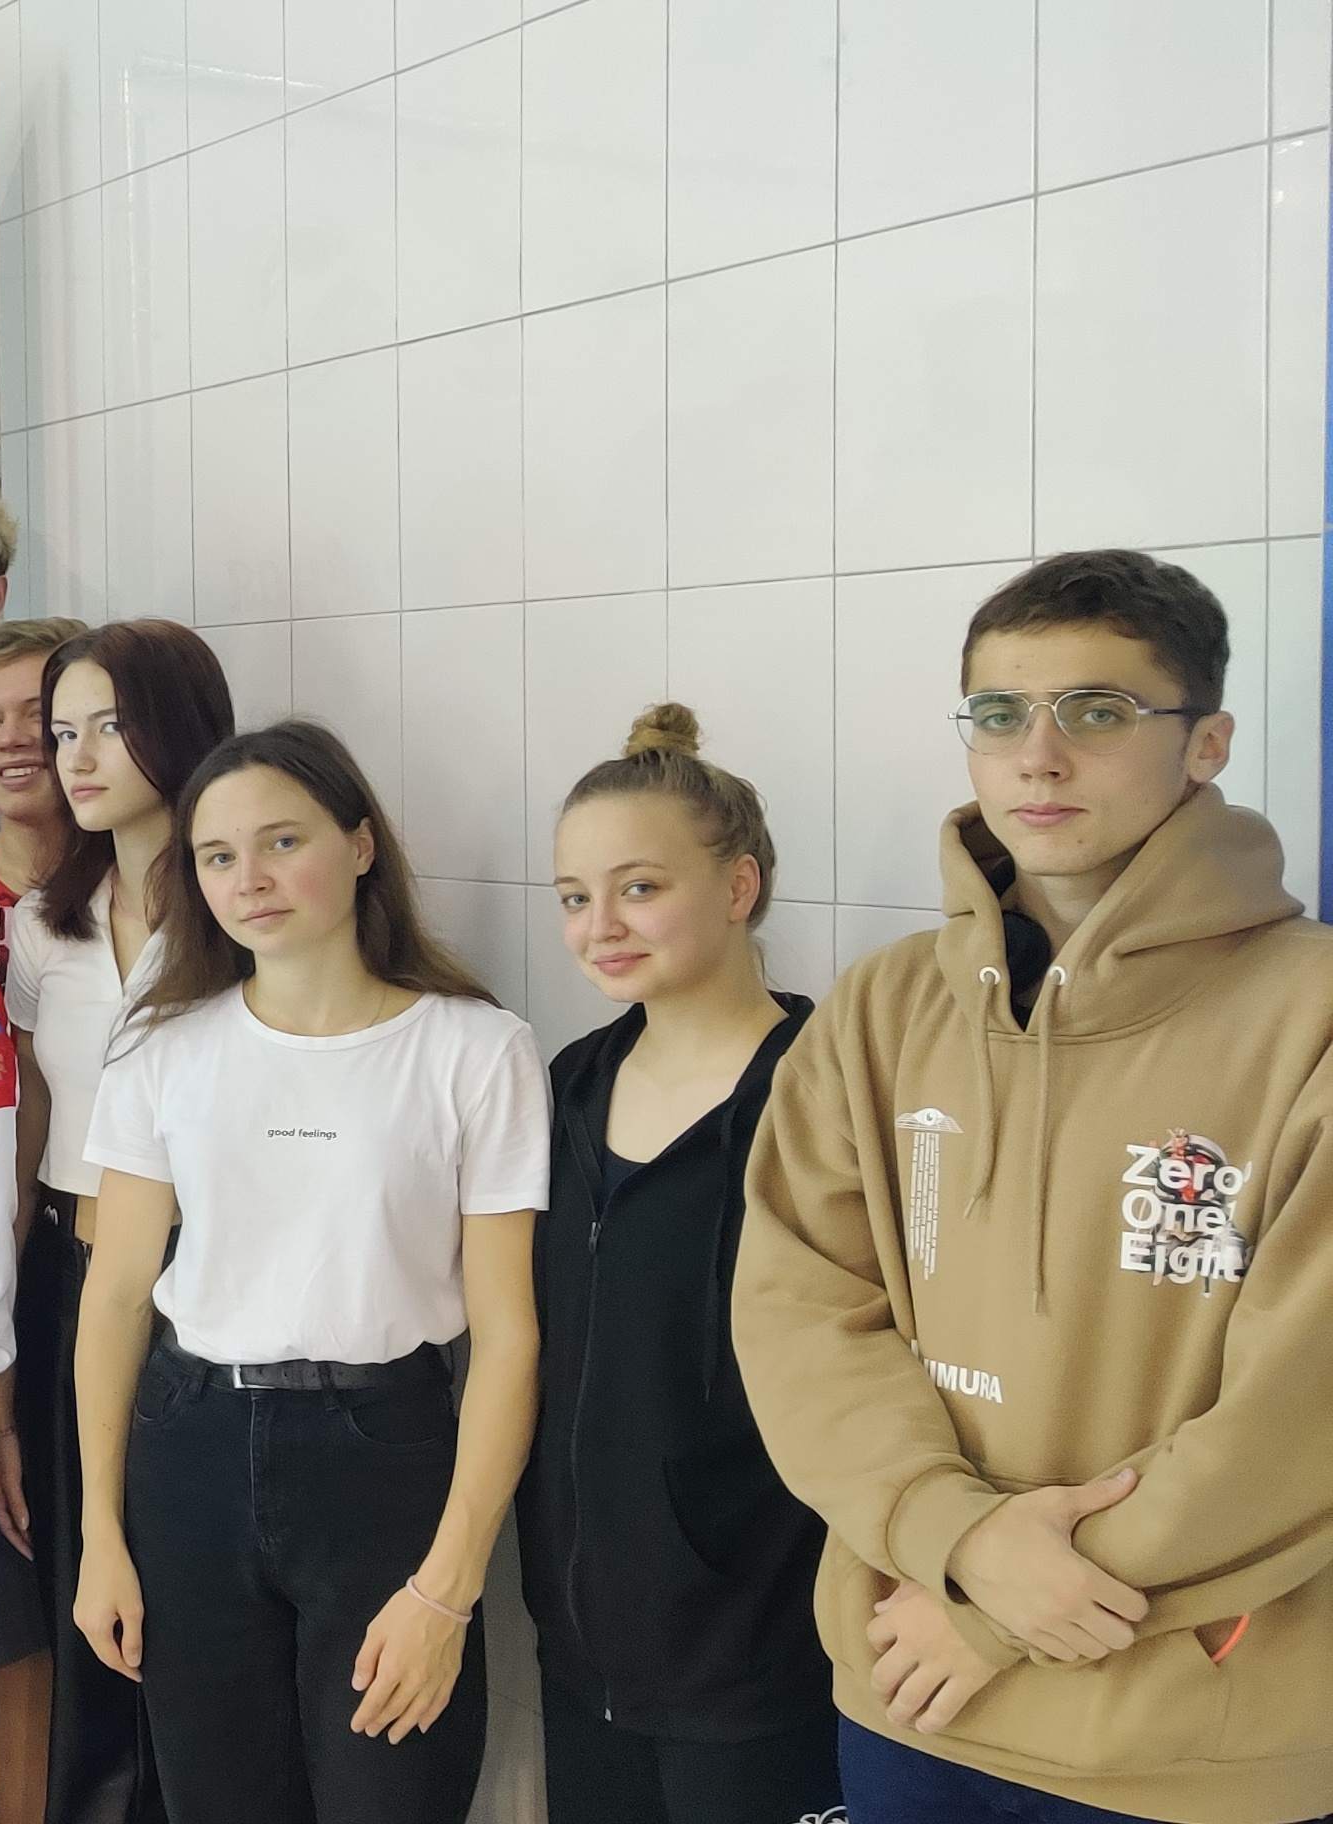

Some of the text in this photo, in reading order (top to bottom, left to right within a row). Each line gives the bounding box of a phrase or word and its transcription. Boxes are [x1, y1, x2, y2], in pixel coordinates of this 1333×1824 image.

[267, 1128, 337, 1141] good feelings
[1121, 1144, 1245, 1196] Zero
[1121, 1188, 1228, 1236] One
[1120, 1230, 1242, 1285] Eight
[922, 1357, 1003, 1404] IMURA
